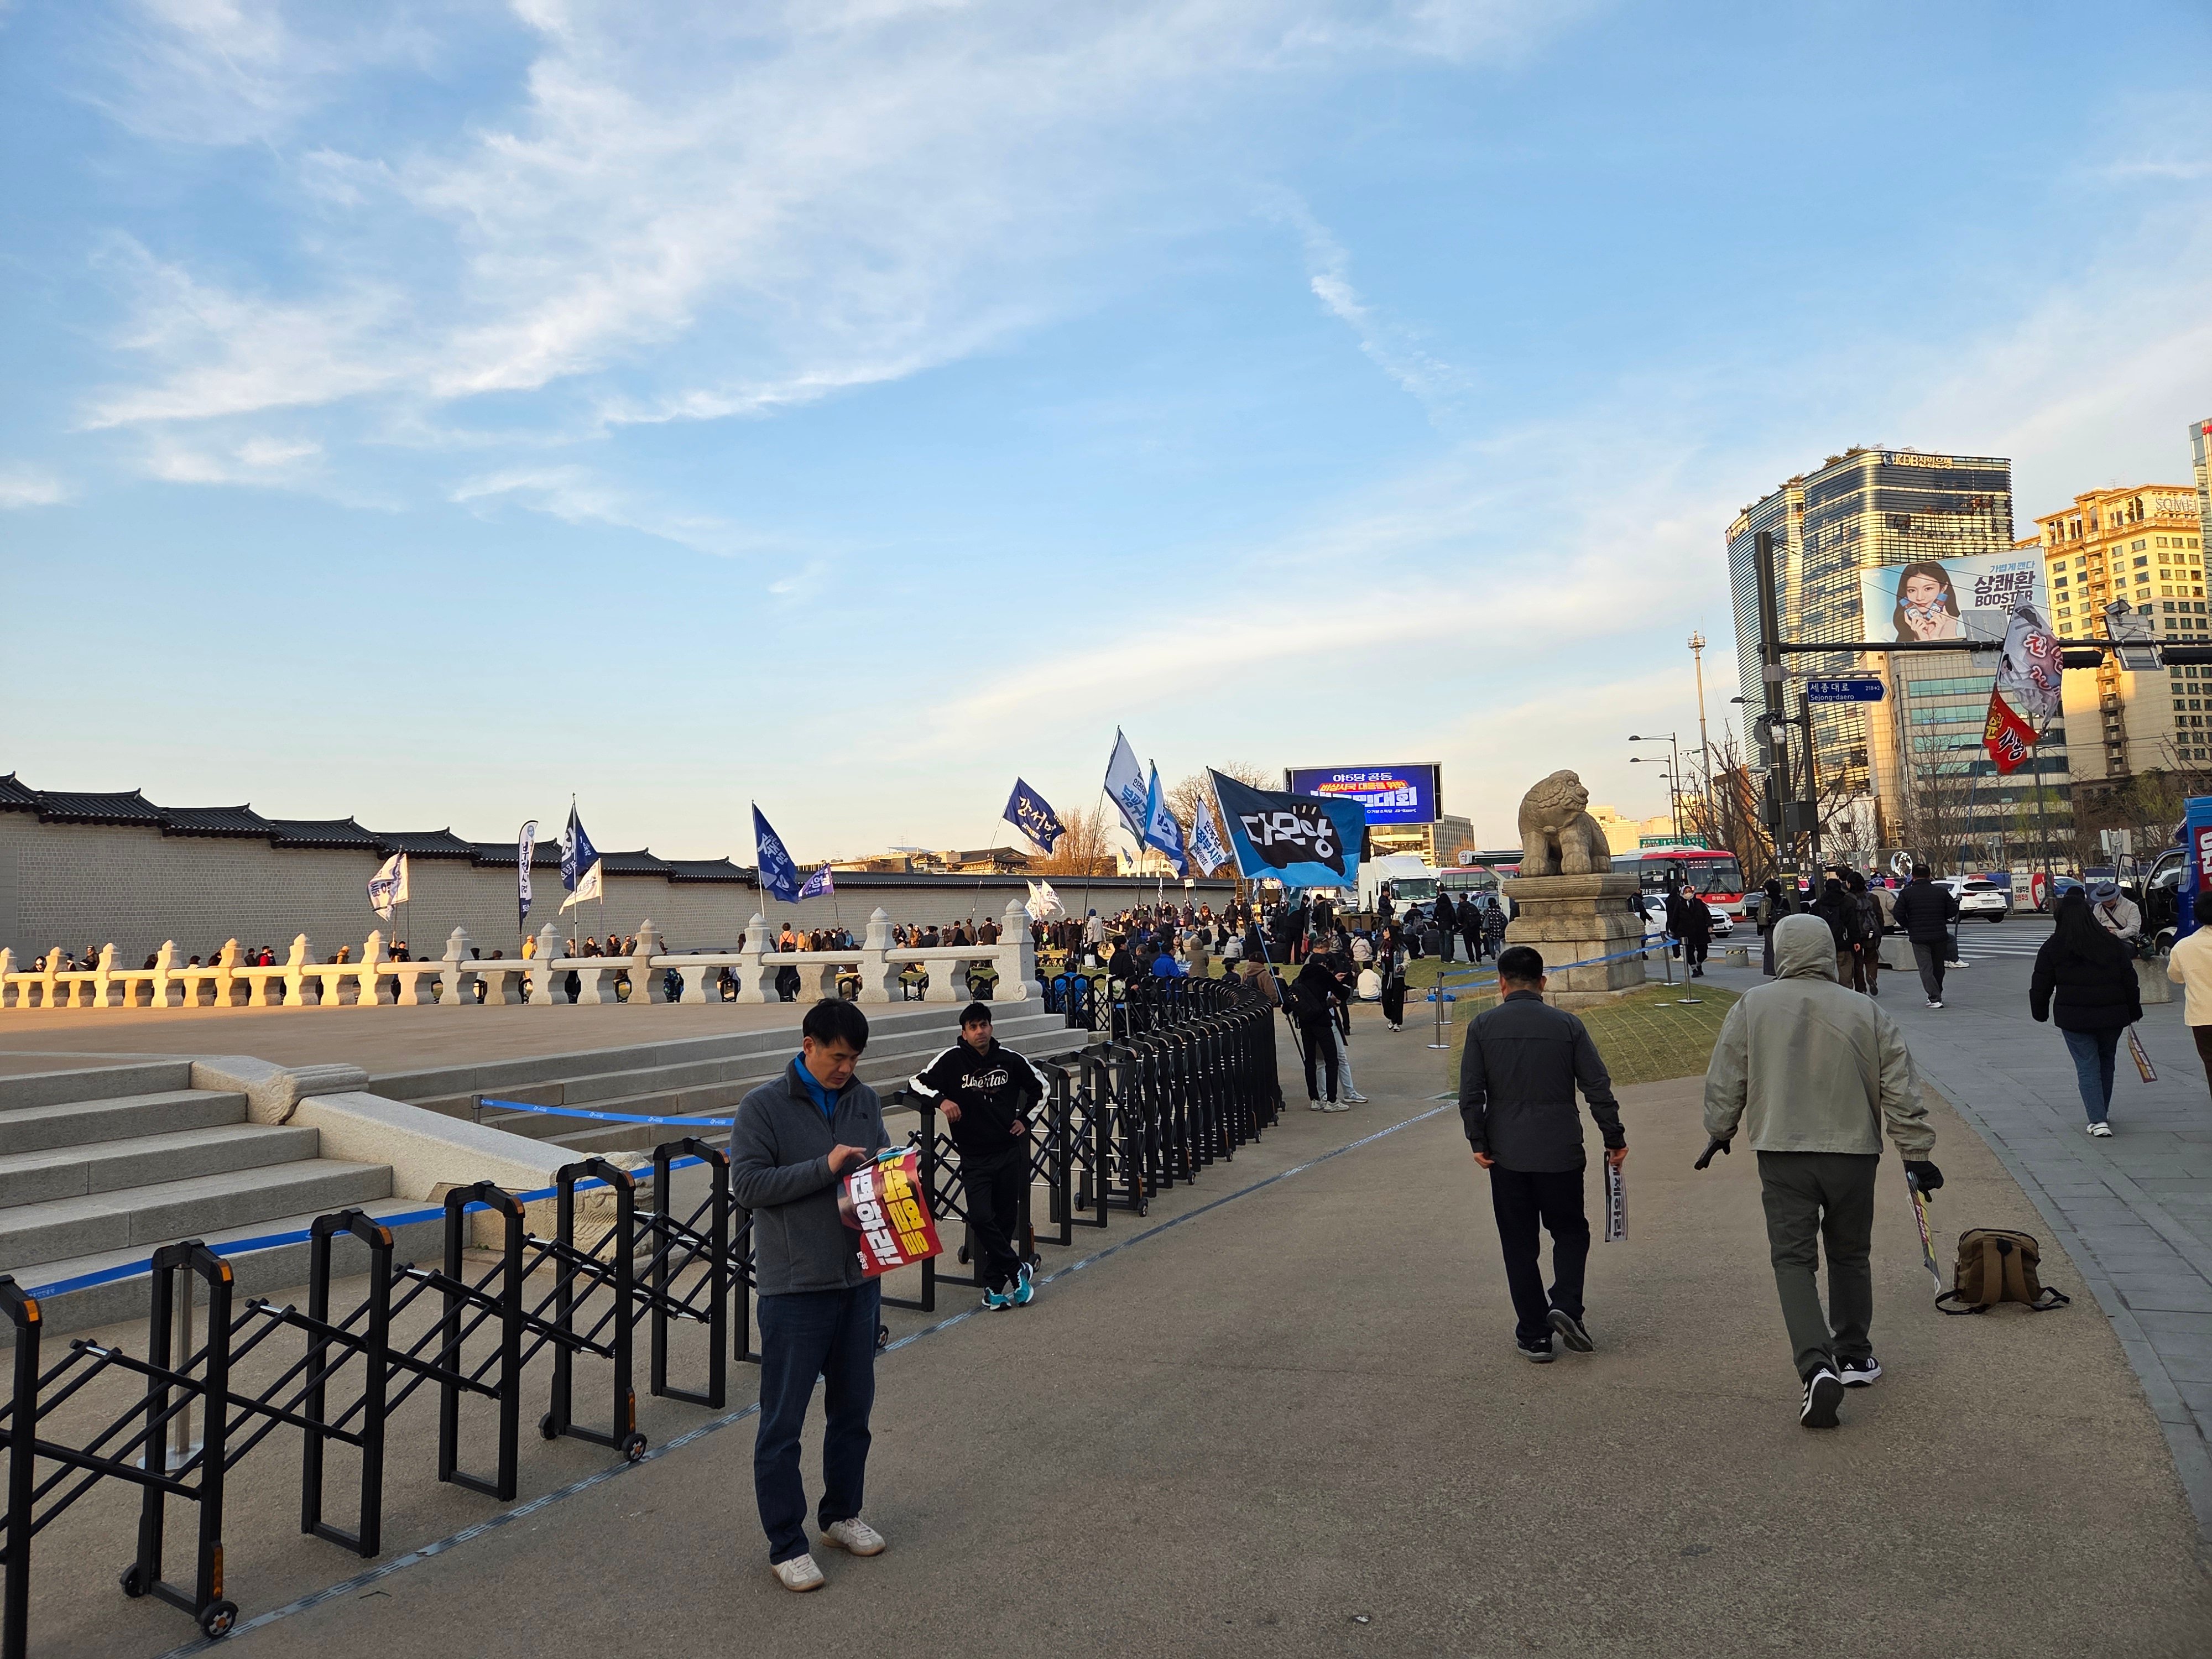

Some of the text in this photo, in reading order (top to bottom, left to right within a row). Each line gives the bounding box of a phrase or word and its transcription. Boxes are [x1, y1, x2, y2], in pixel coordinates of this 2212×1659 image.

[1895, 453, 1954, 469] KDB산업은행
[1990, 560, 2036, 573] 가볍게 깬다
[1974, 571, 2036, 594] 상쾌환
[1975, 589, 2033, 607] BOOSTR
[1810, 682, 1850, 693] 세종대로
[1333, 772, 1393, 782] 야5당 공동
[1320, 782, 1357, 791] 비상시국
[1387, 780, 1406, 789] 위한
[1310, 786, 1417, 807] 민대회
[1239, 812, 1334, 858] 다모앙
[1197, 826, 1223, 867] 정부시을
[961, 1073, 1007, 1089] Libertas
